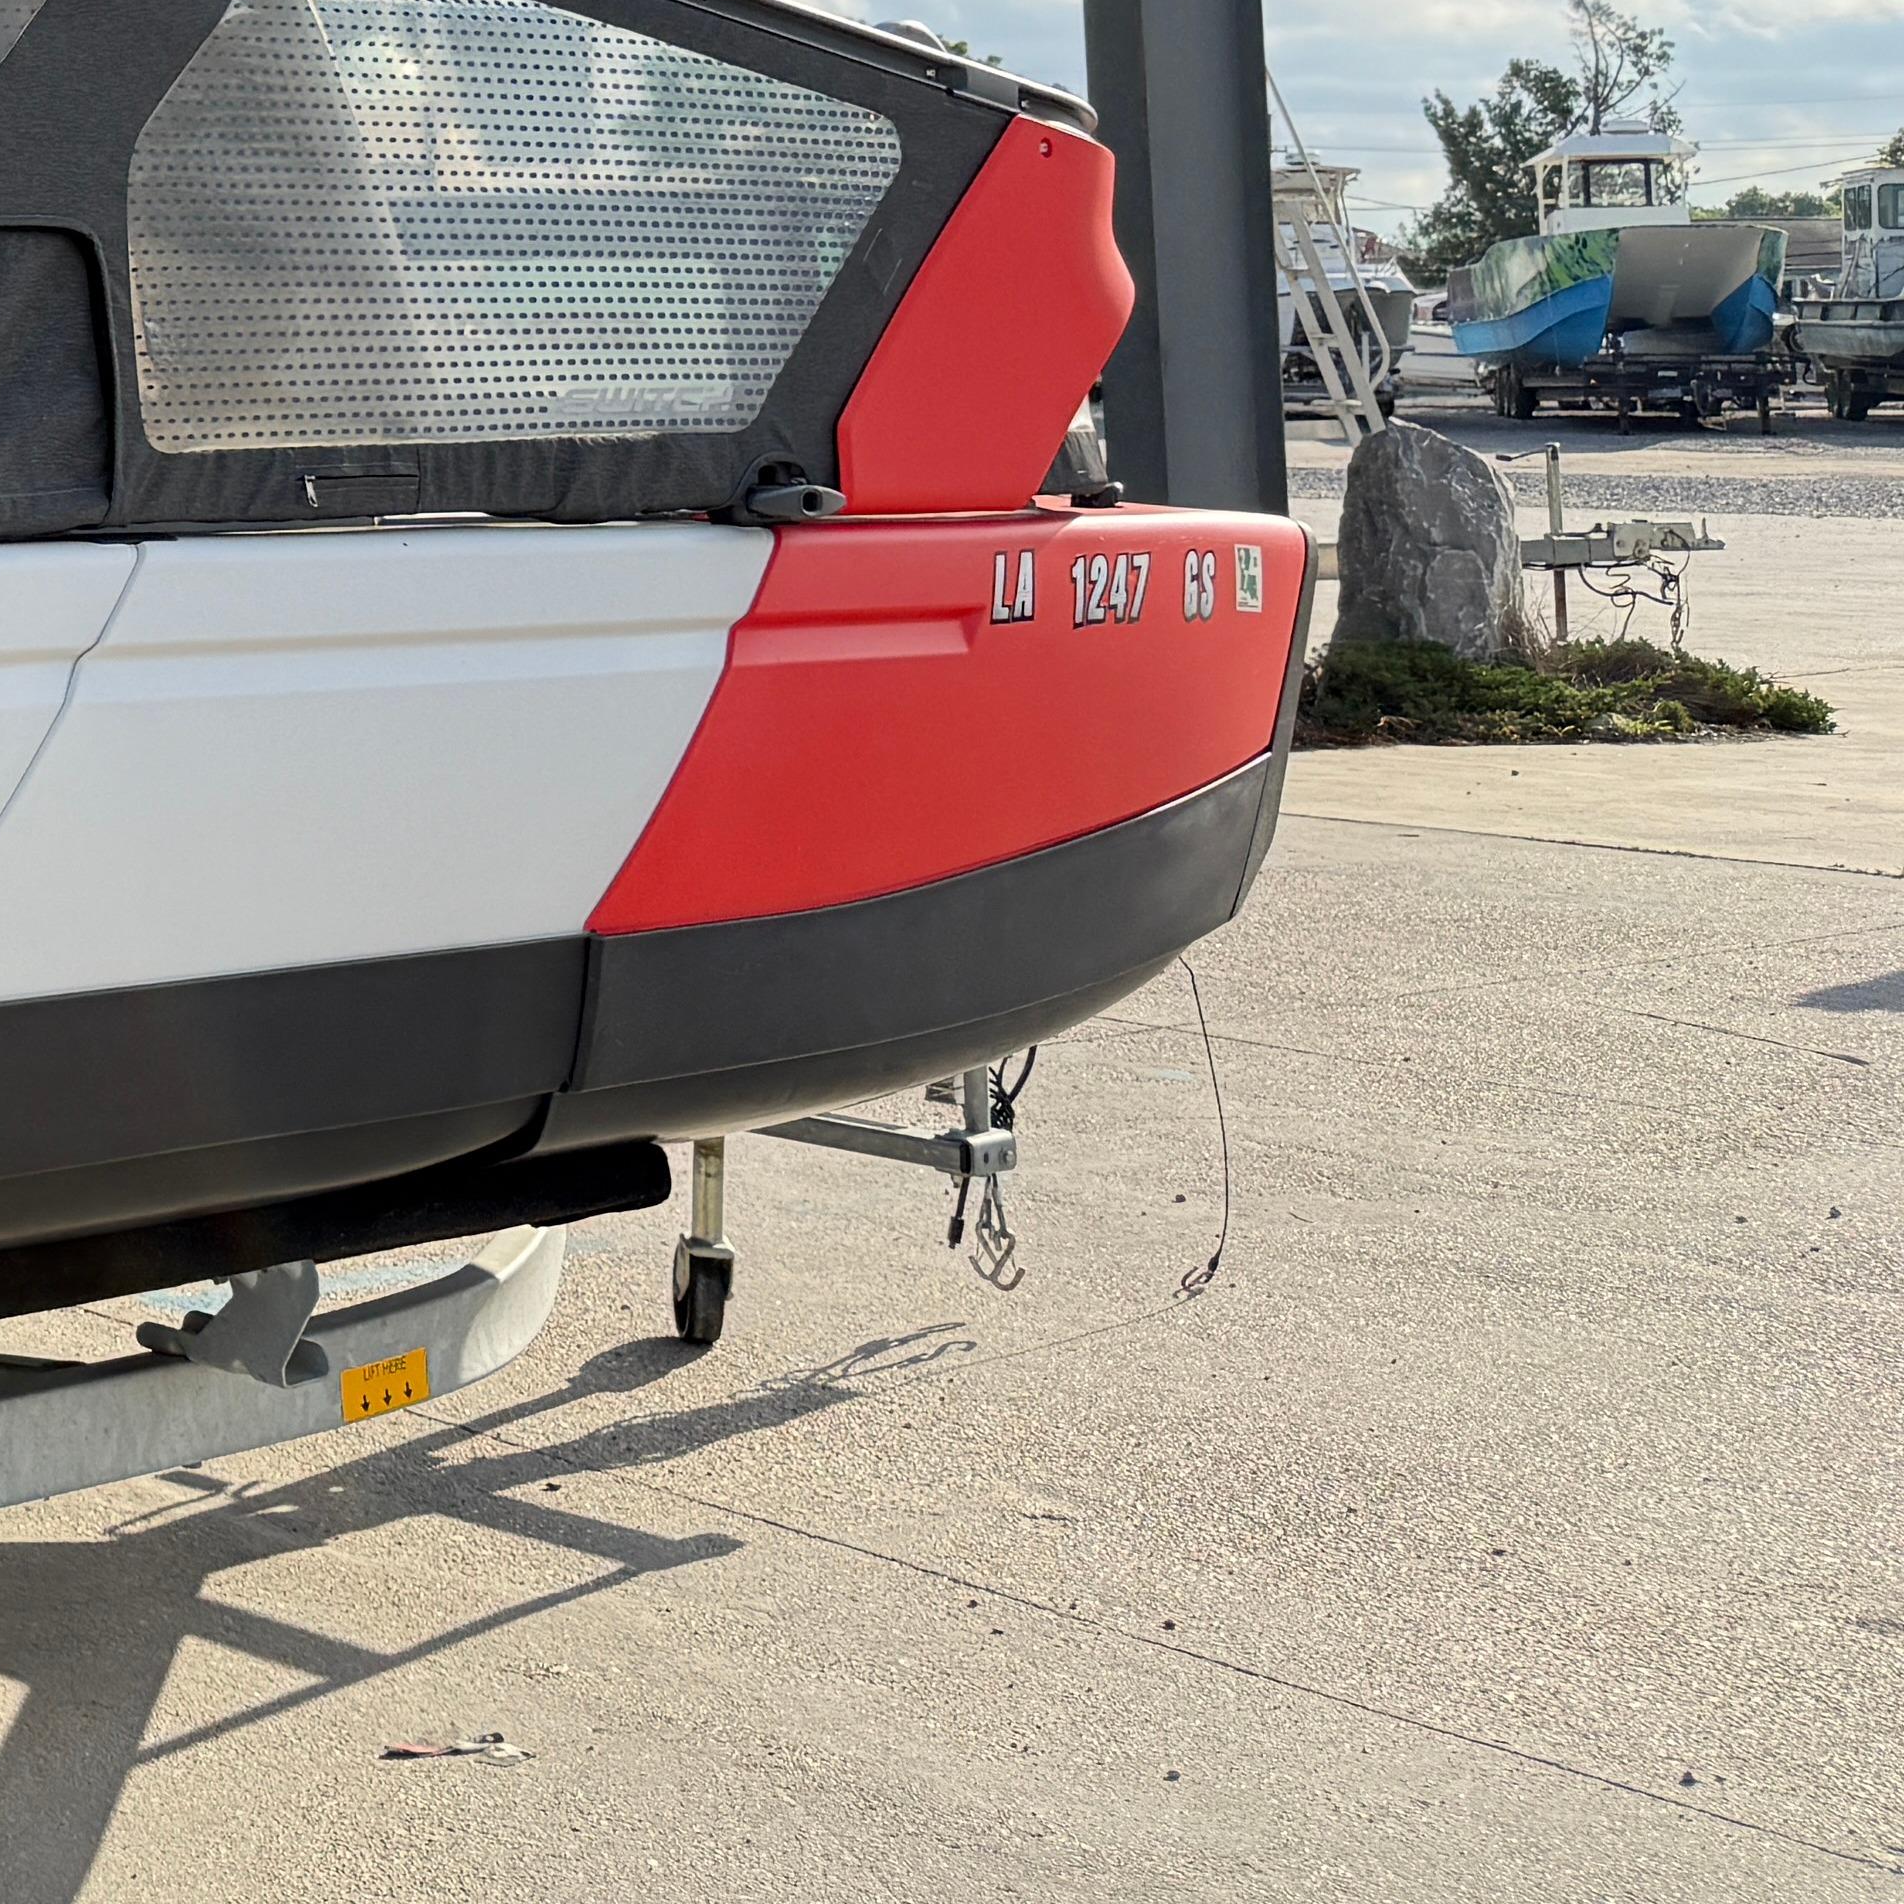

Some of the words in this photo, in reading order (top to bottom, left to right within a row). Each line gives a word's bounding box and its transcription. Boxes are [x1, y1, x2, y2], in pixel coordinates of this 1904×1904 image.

[989, 549, 1036, 625] LA
[1071, 550, 1152, 629] 1247
[1182, 548, 1217, 624] GS
[363, 1362, 380, 1382] LIFT
